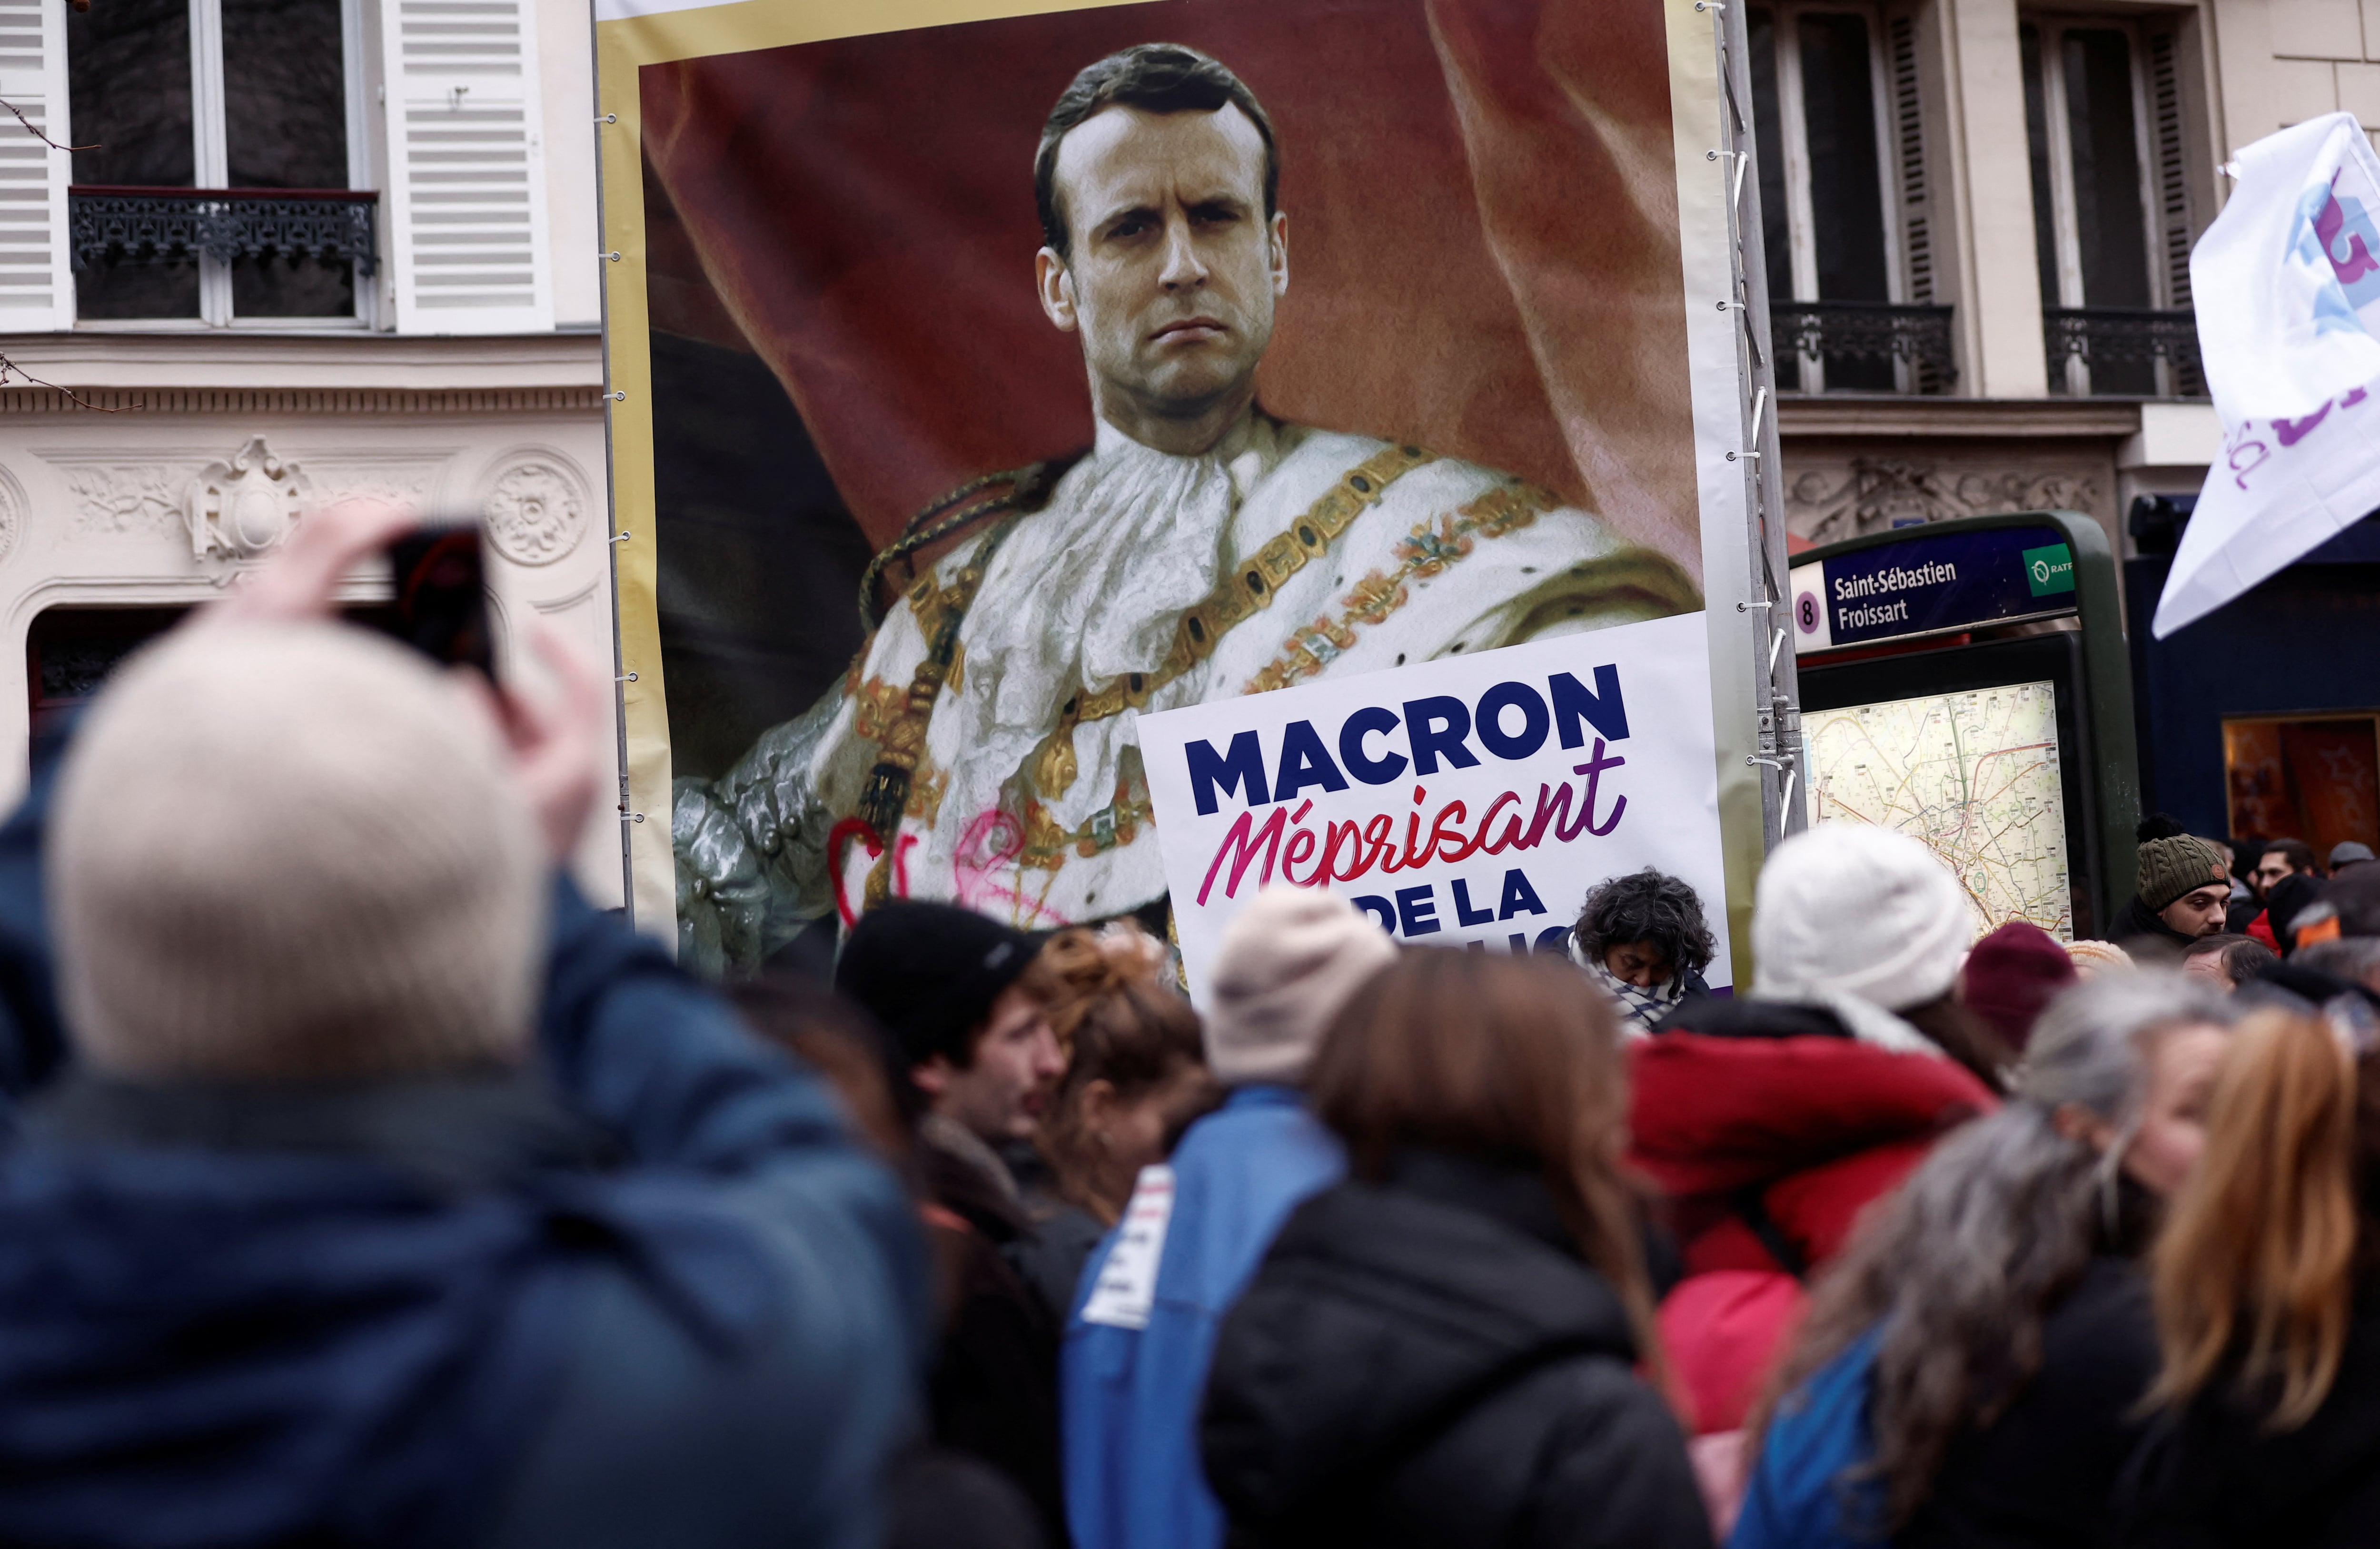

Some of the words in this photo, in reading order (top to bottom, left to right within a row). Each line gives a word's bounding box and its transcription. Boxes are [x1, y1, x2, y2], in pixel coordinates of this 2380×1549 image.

[1834, 560, 1957, 601] Saint-Sébastien
[1802, 600, 1813, 626] 8
[1838, 599, 1908, 630] Froissart
[1184, 663, 1630, 816] MACRON
[1196, 737, 1627, 907] Méprisant
[1350, 884, 1441, 937] DE
[1451, 868, 1548, 927] LA
